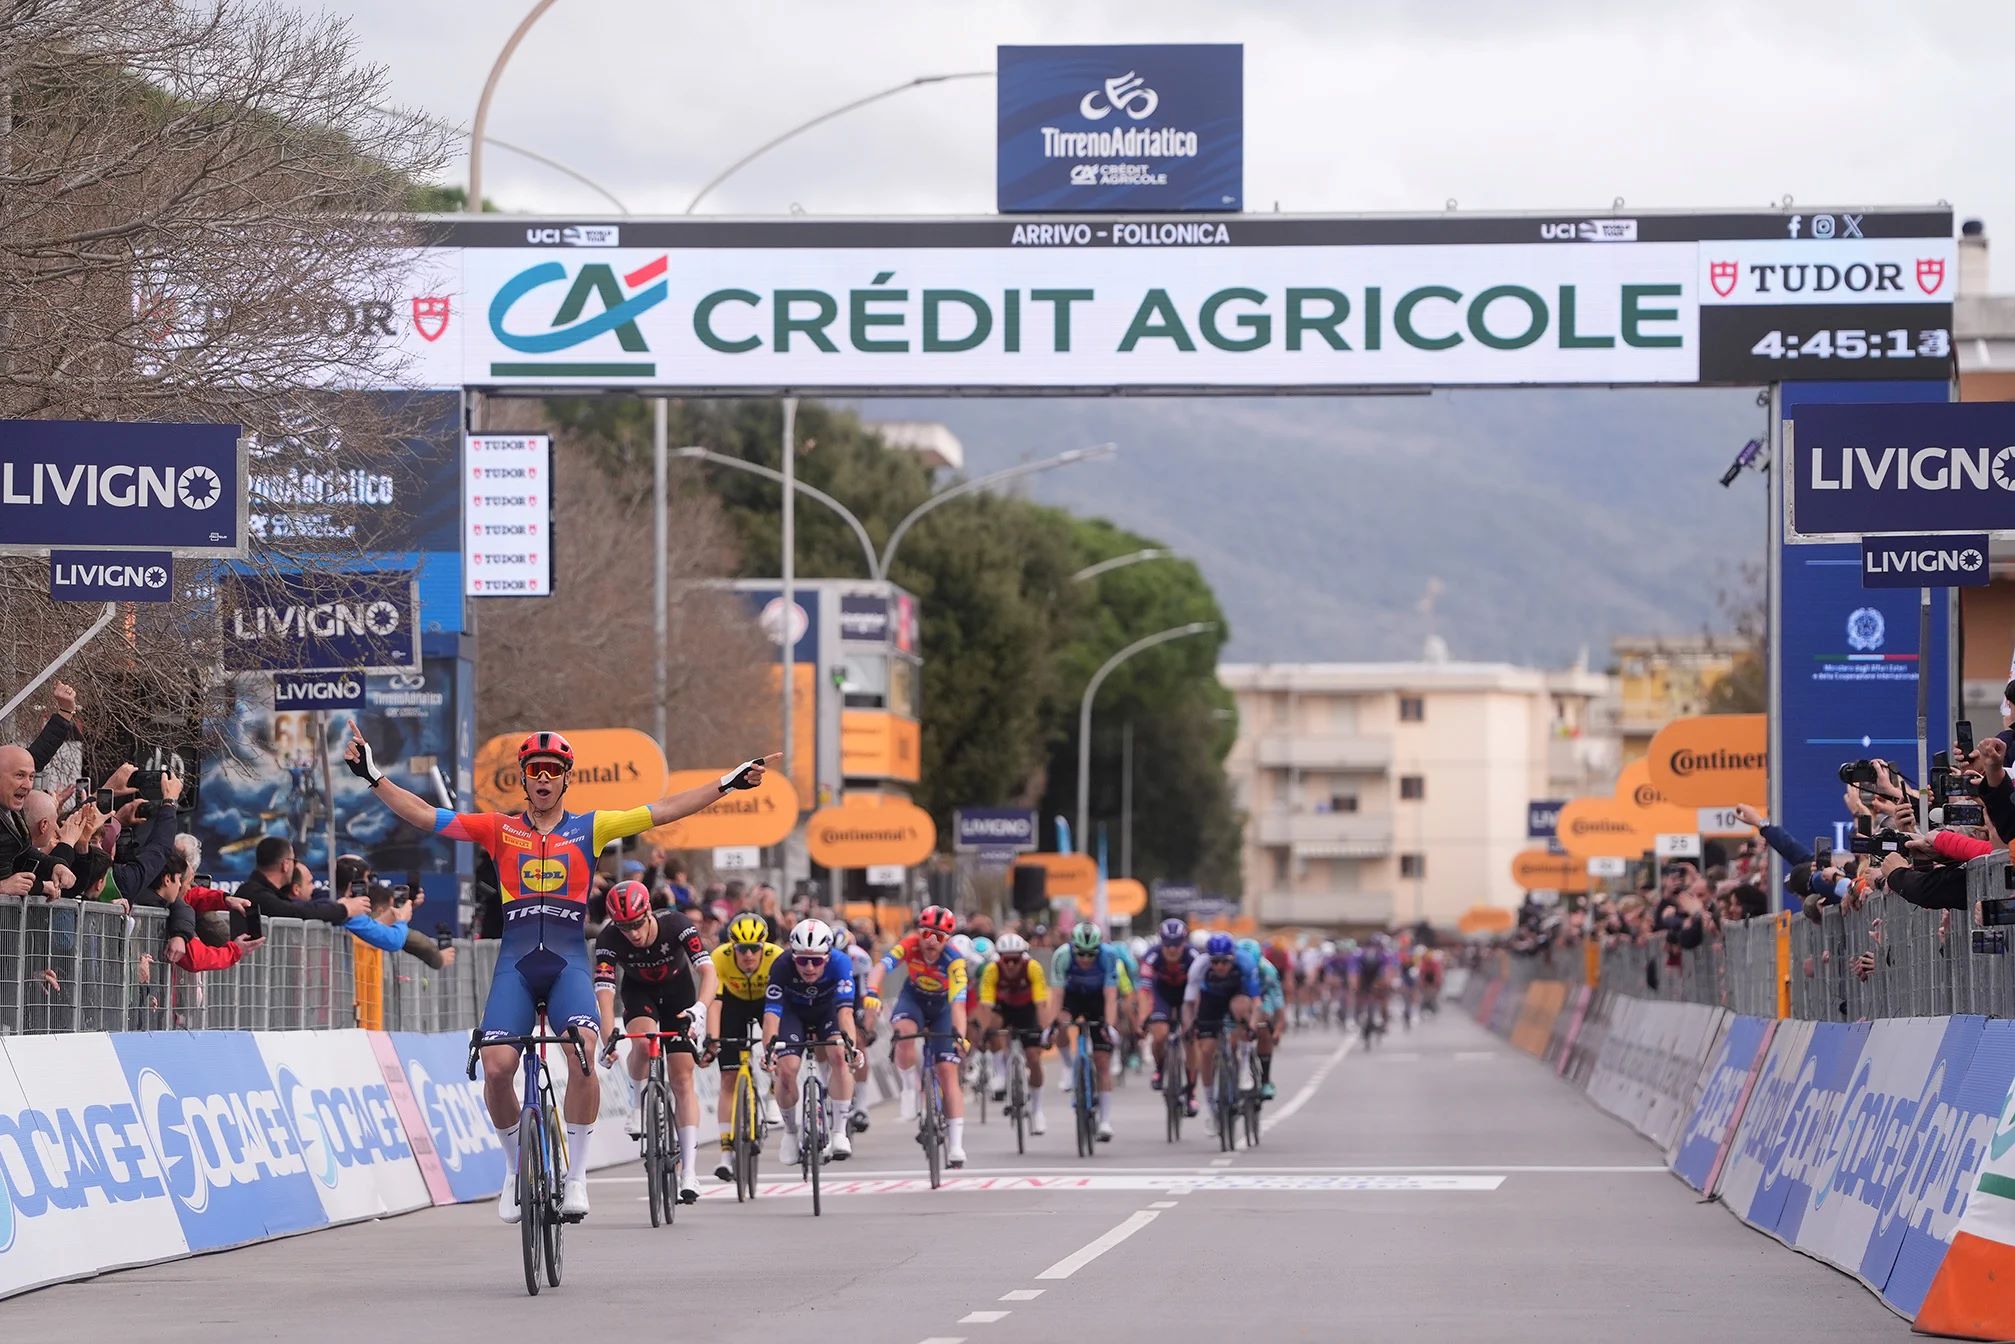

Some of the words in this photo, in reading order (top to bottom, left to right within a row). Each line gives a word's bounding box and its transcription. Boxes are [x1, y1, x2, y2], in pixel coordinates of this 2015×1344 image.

[1041, 127, 1198, 157] TirrenoAdriatico
[1100, 174, 1167, 185] AGRICOLE
[526, 228, 560, 243] UCI
[1011, 224, 1091, 245] ARRIVO
[1112, 223, 1230, 244] FOLLONICA
[1540, 223, 1576, 239] UCI
[1750, 263, 1905, 292] TUDOR
[693, 271, 1093, 354] CRÉDIT
[1117, 284, 1683, 352] AGRICOLE
[484, 440, 526, 450] TUDOR
[484, 468, 526, 478] TUDOR
[3, 464, 221, 510] LIVIGNO
[484, 496, 526, 506] TUDOR
[484, 525, 526, 535] TUDOR
[484, 554, 526, 564] TUDOR
[1866, 549, 1983, 573] LIVIGNO
[55, 565, 167, 588] LIVIGNO
[484, 580, 526, 590] TUDOR
[233, 600, 399, 640] LIVIGNO
[275, 681, 361, 701] LIVIGNO
[1716, 812, 1736, 828] 10
[502, 824, 532, 839] Santini
[507, 905, 581, 922] TREK
[277, 1062, 411, 1190] SOCAGE
[1815, 1057, 1921, 1211] SOCAGE
[138, 1067, 305, 1214] SOCAGE
[0, 1102, 169, 1225] OCAGE
